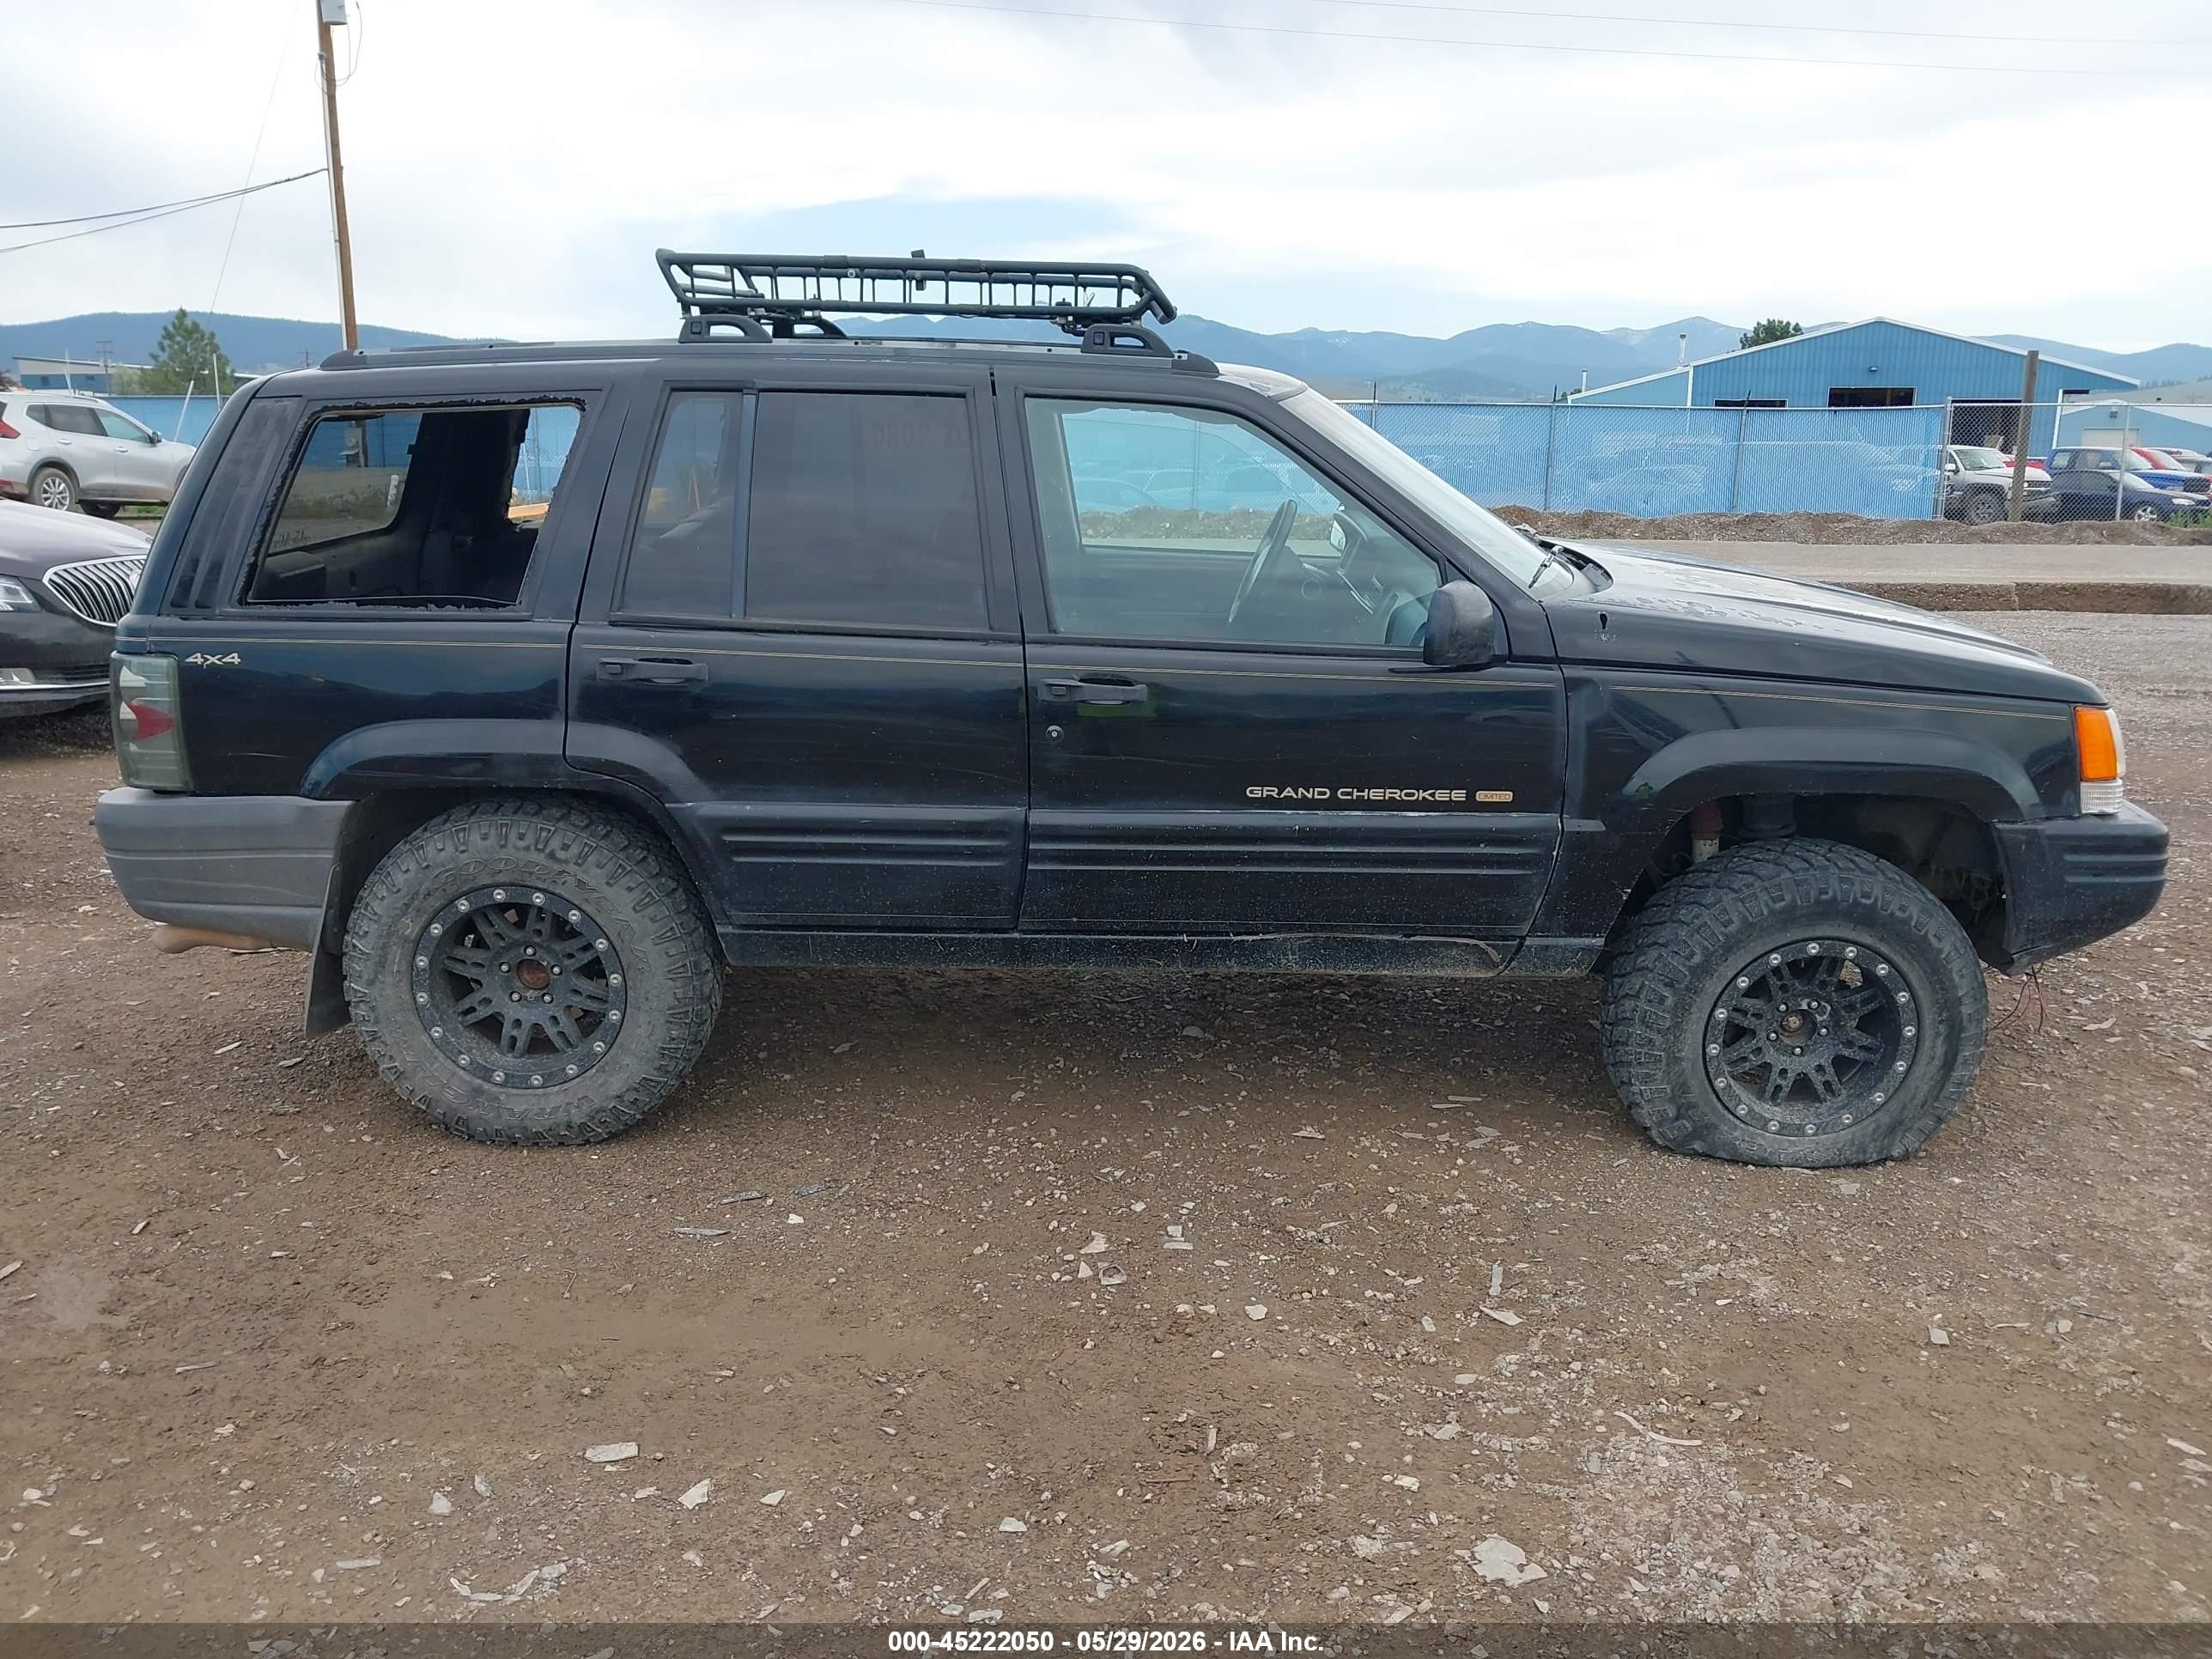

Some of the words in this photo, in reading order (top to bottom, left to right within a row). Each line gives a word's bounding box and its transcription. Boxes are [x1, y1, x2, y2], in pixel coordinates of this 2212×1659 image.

[1245, 786, 1330, 799] GRAND
[1337, 788, 1467, 801] CHEROKEE
[1478, 792, 1511, 800] LIMITED
[432, 856, 653, 973] GOODYEAR
